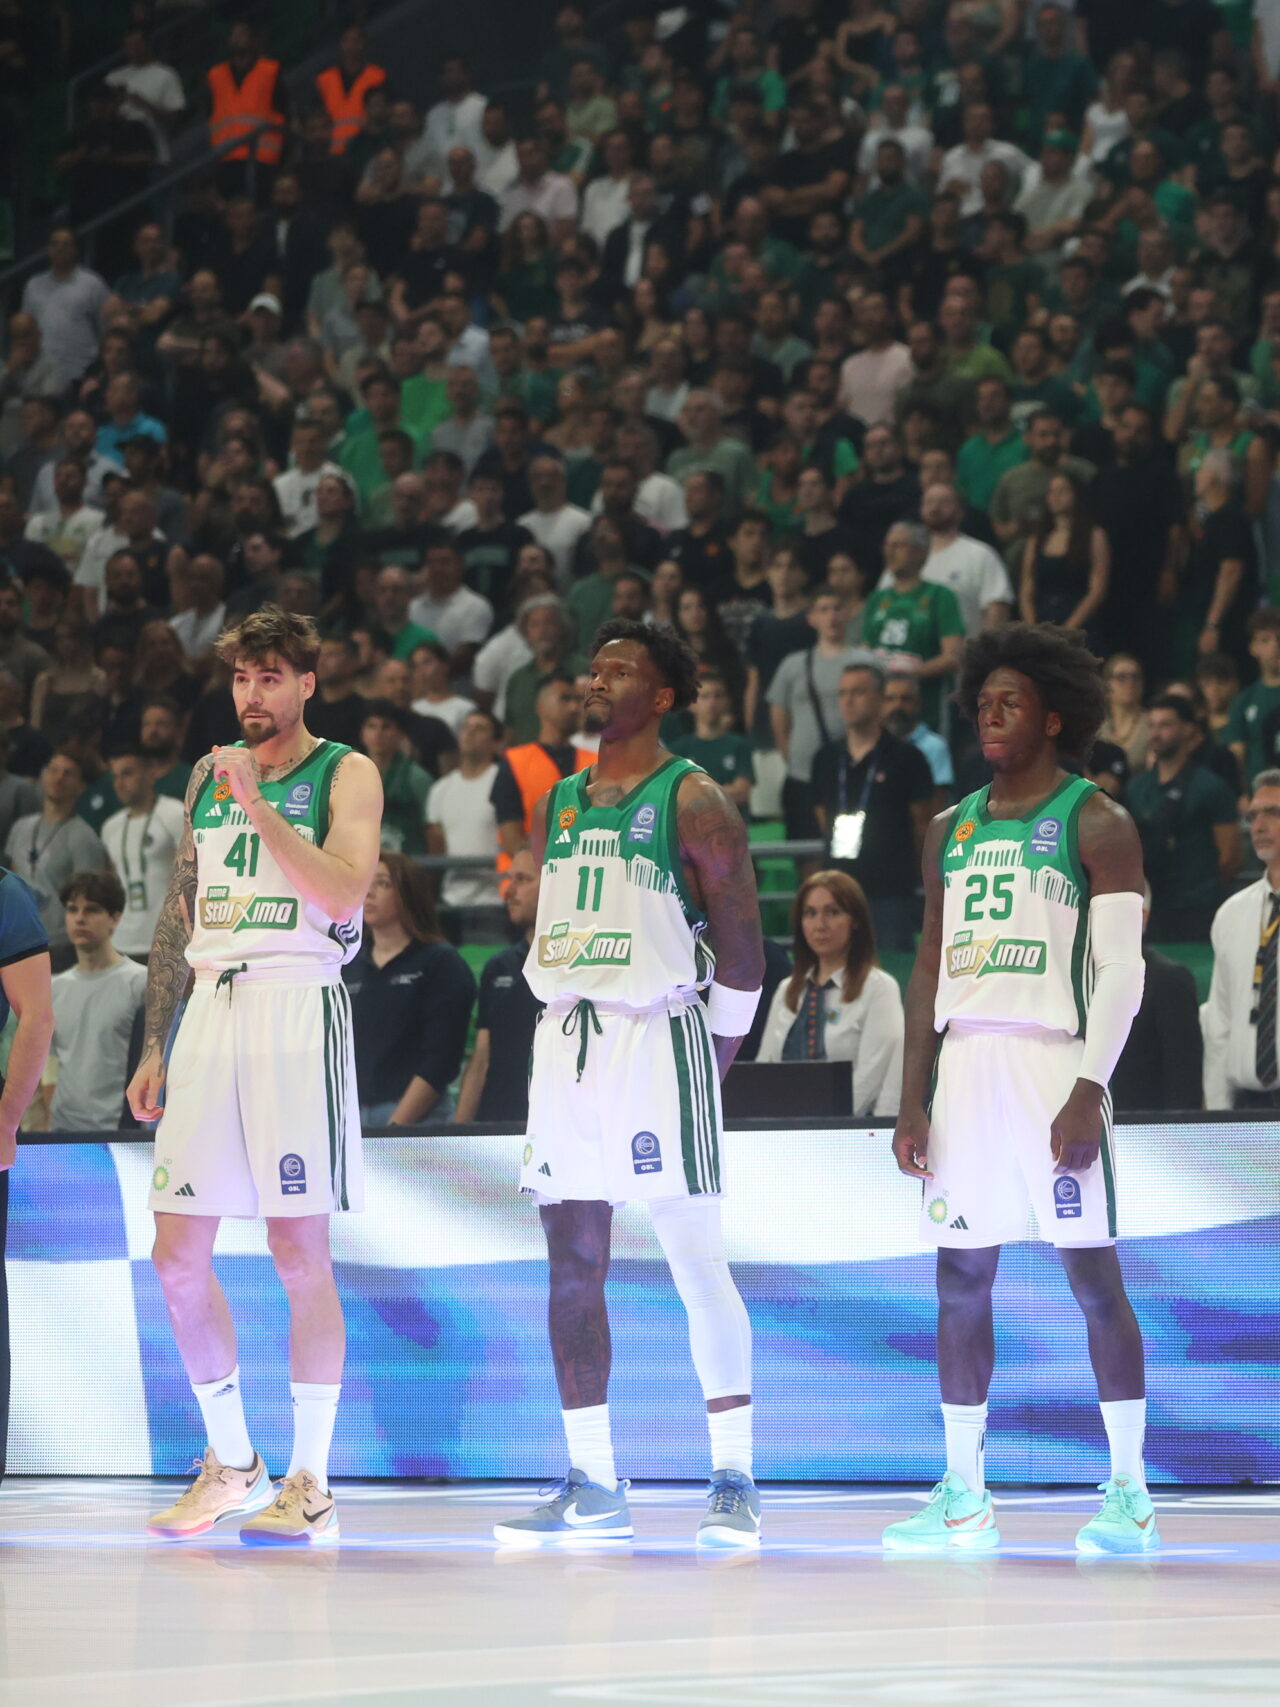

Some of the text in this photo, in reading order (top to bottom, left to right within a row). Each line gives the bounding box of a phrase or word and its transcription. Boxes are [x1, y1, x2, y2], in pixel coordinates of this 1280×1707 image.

[223, 832, 261, 877] 41
[576, 865, 605, 912] 11
[964, 873, 1015, 922] 25
